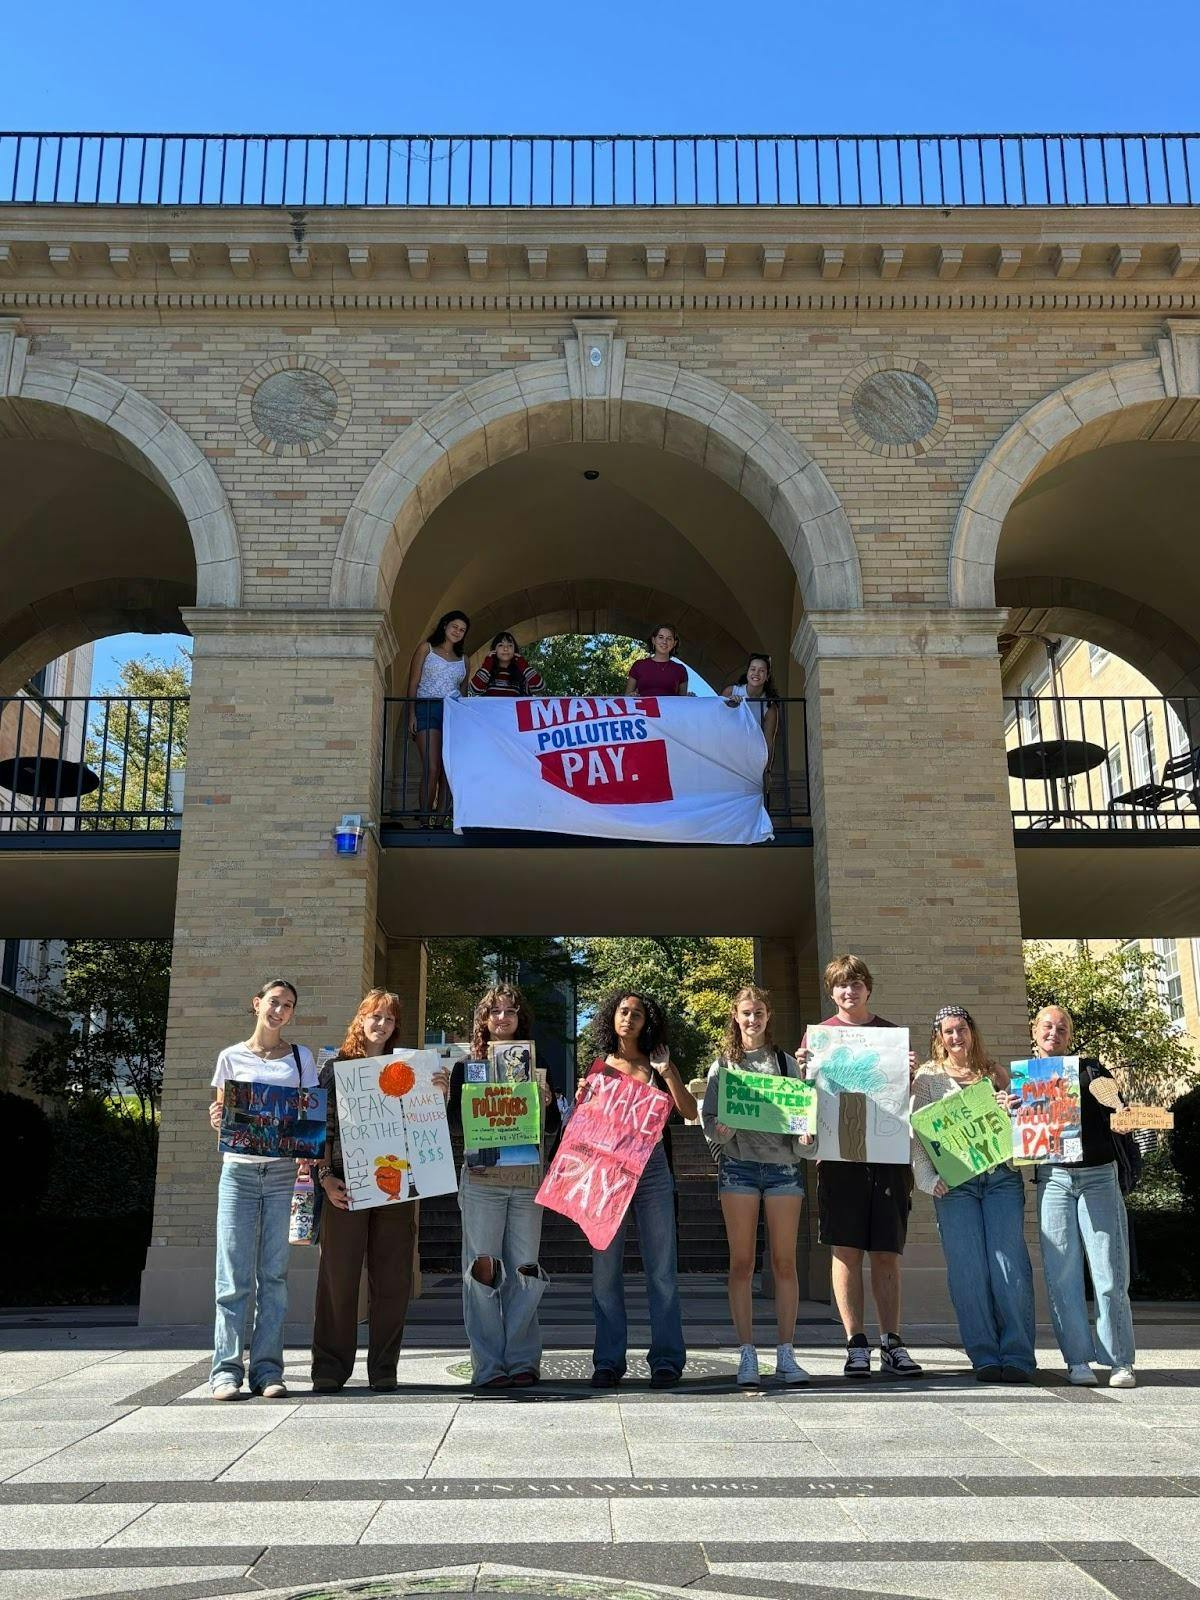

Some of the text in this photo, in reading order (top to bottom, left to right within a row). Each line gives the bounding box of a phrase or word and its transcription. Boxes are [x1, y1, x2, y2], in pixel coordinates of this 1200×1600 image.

[529, 698, 647, 729] MAKE
[537, 718, 648, 751] POLLUTERS
[560, 746, 640, 788] PAY.
[336, 1065, 375, 1093] WE
[726, 1072, 774, 1089] MAKE
[1022, 1079, 1069, 1101] MAKE
[339, 1093, 395, 1122] SPEAK
[408, 1093, 444, 1109] MAKE
[471, 1097, 528, 1118] POLLUTERS
[584, 1072, 669, 1136] MAKE
[726, 1085, 812, 1107] POLLUTERS
[405, 1111, 447, 1125] POLLUTERS
[726, 1101, 760, 1118] PAY!
[931, 1106, 973, 1133] MAKE
[341, 1121, 401, 1144] FOR THE
[412, 1128, 438, 1147] PAY
[345, 1147, 372, 1210] TREES
[544, 1153, 629, 1217] PAY
